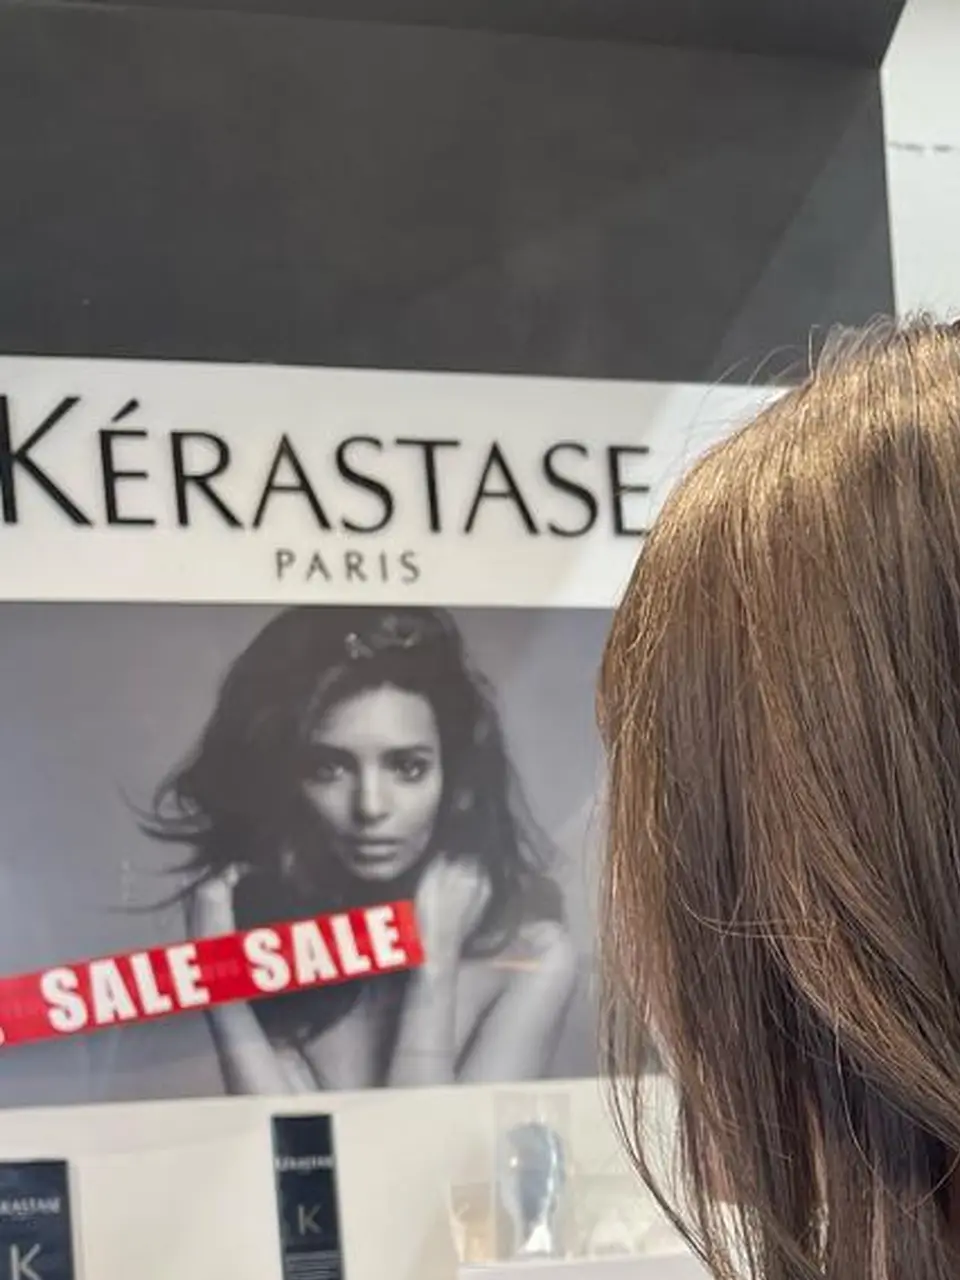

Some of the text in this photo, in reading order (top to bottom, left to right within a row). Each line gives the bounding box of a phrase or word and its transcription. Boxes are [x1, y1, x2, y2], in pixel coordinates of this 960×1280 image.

[0, 396, 651, 538] KÉRASTASE
[275, 549, 421, 582] PARIS
[40, 904, 407, 1033] SALE SALE
[297, 1203, 322, 1235] K
